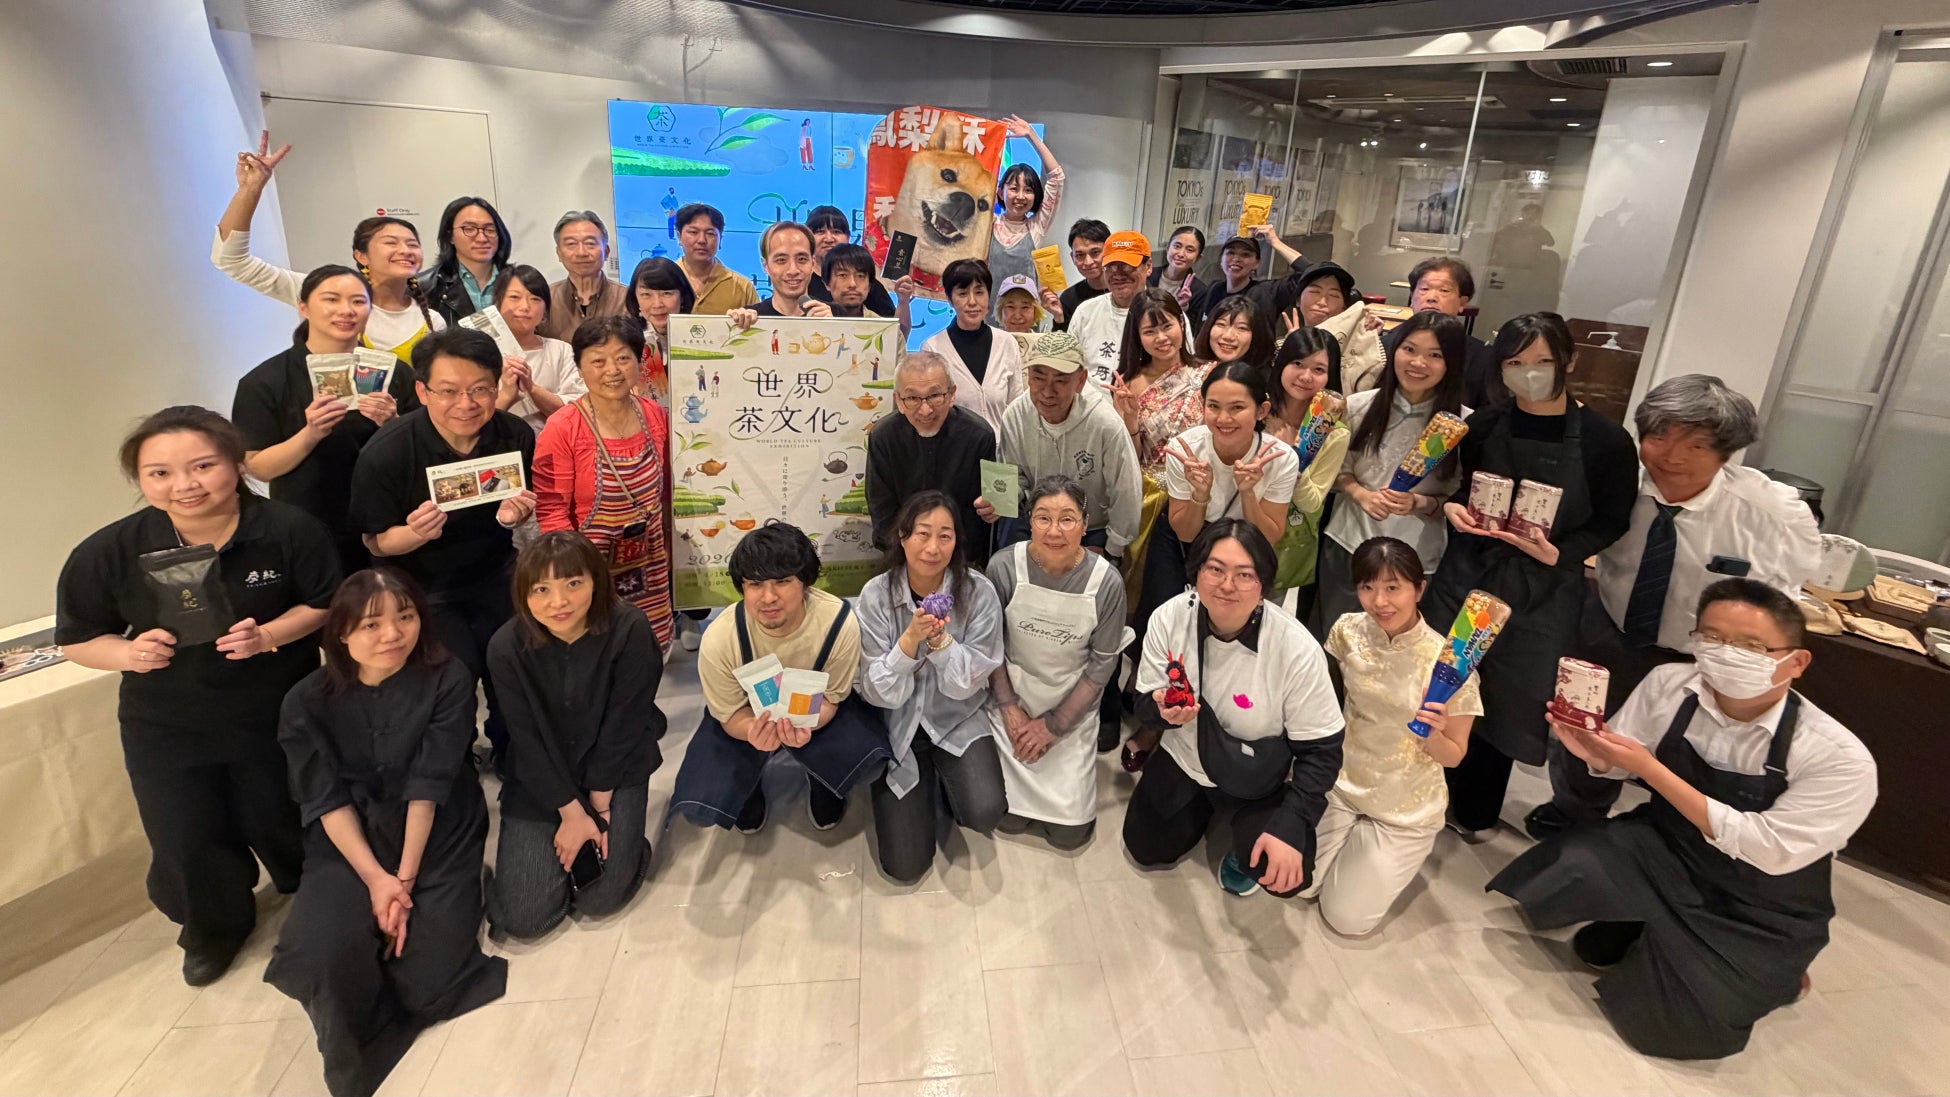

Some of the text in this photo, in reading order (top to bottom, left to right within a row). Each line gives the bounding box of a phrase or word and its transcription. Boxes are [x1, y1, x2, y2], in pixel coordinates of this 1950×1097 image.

[748, 367, 830, 399] 世界
[729, 405, 849, 441] 茶文化
